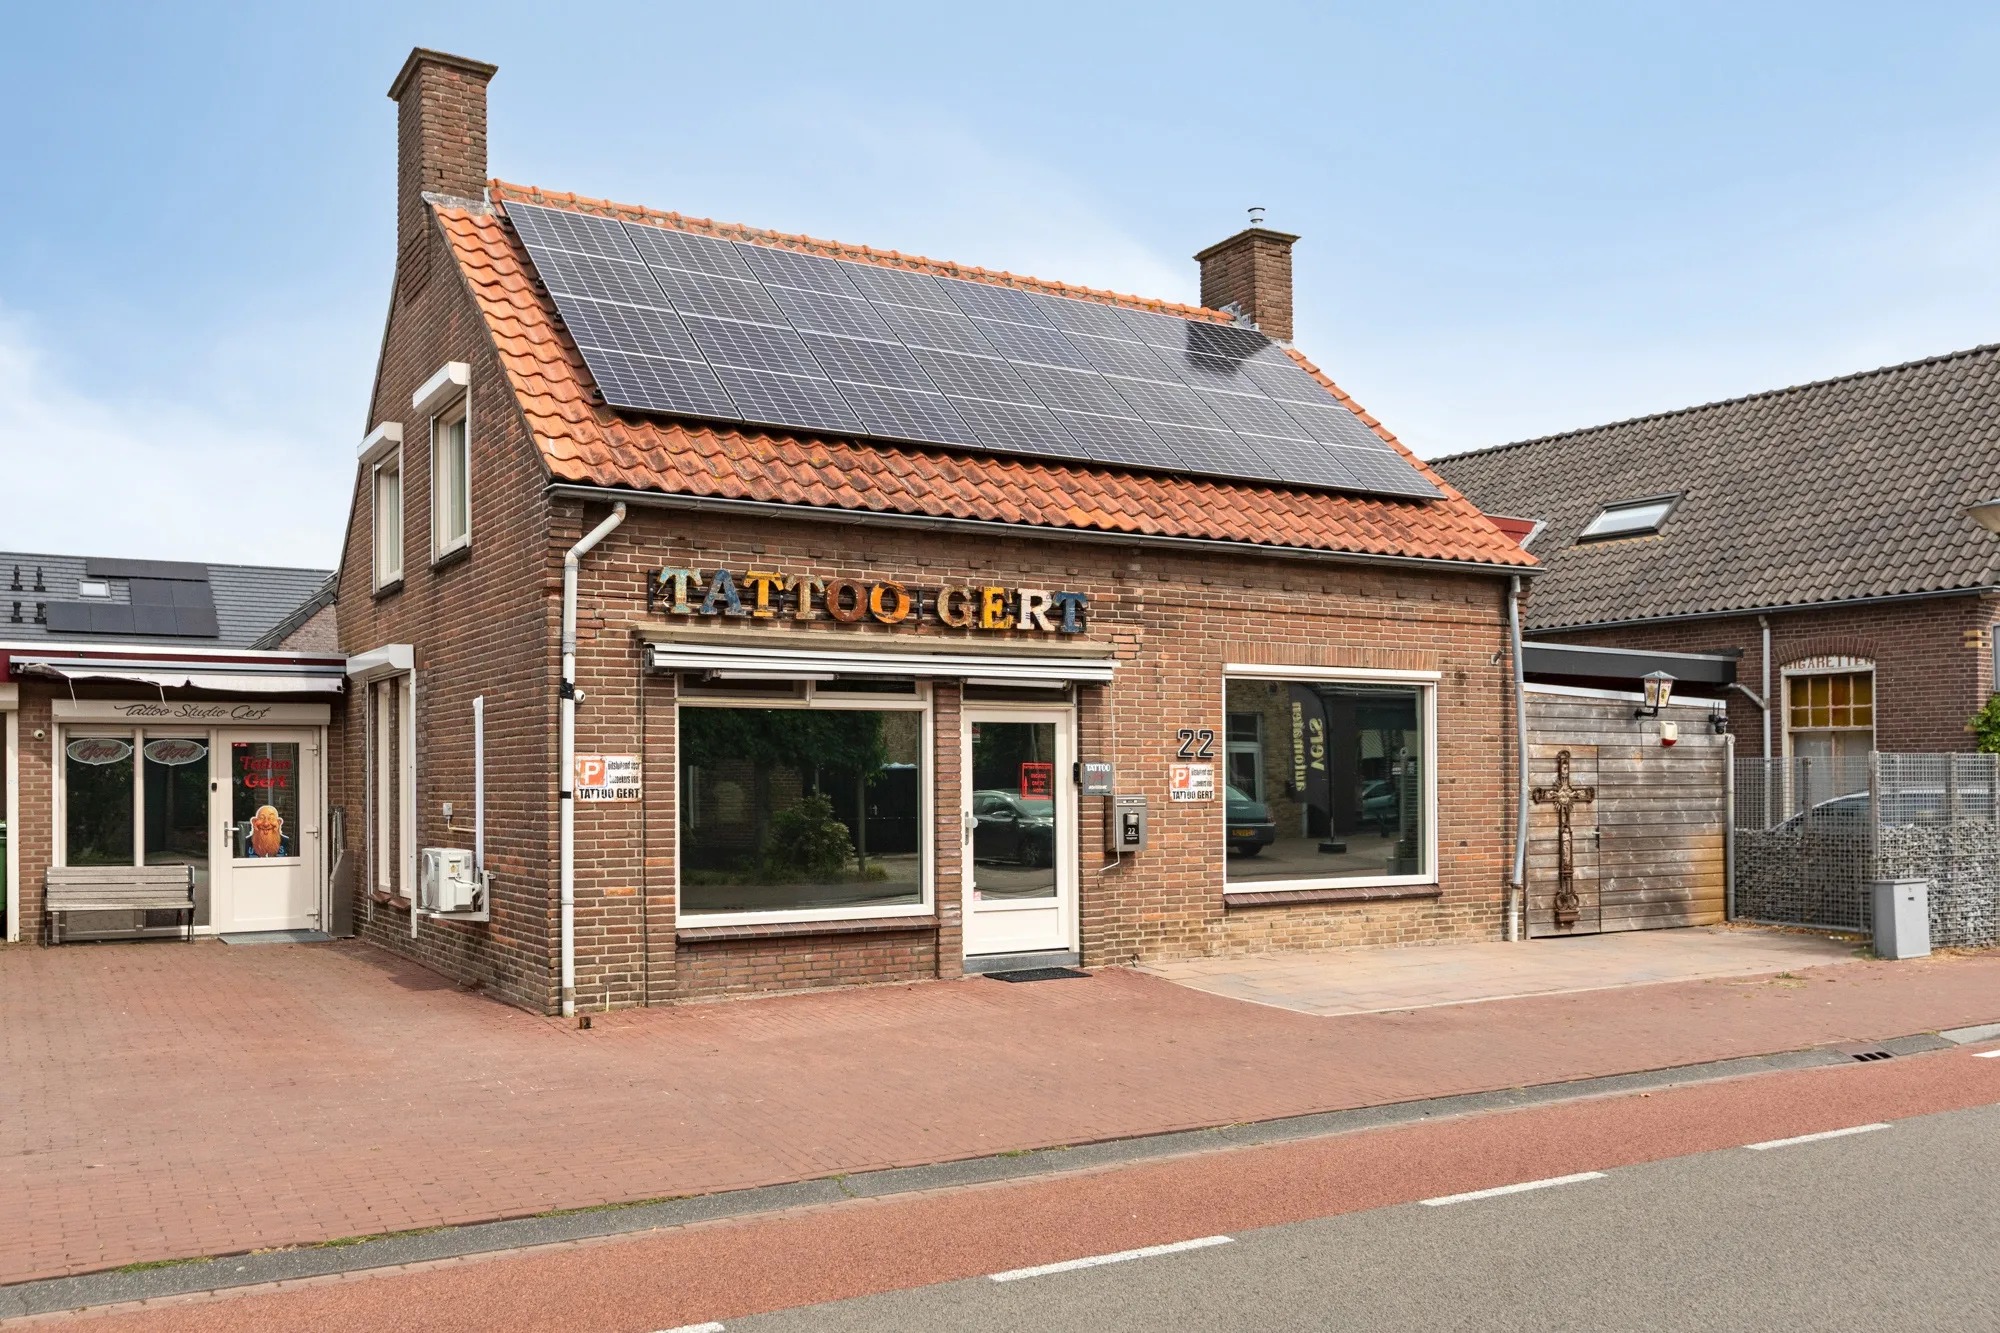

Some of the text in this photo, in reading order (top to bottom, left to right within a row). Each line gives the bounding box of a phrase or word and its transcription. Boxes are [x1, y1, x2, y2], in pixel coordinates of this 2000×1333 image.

[660, 566, 1088, 633] TATTOO GERT
[114, 704, 271, 720] Tattoo Studio Gert
[1177, 729, 1214, 757] 22
[585, 762, 601, 784] P
[1085, 763, 1111, 772] TATTOO
[244, 773, 287, 788] Gert
[1176, 769, 1187, 788] P
[579, 788, 640, 799] TATTOO GERT
[1197, 790, 1213, 799] GERT
[1127, 827, 1136, 835] 22
